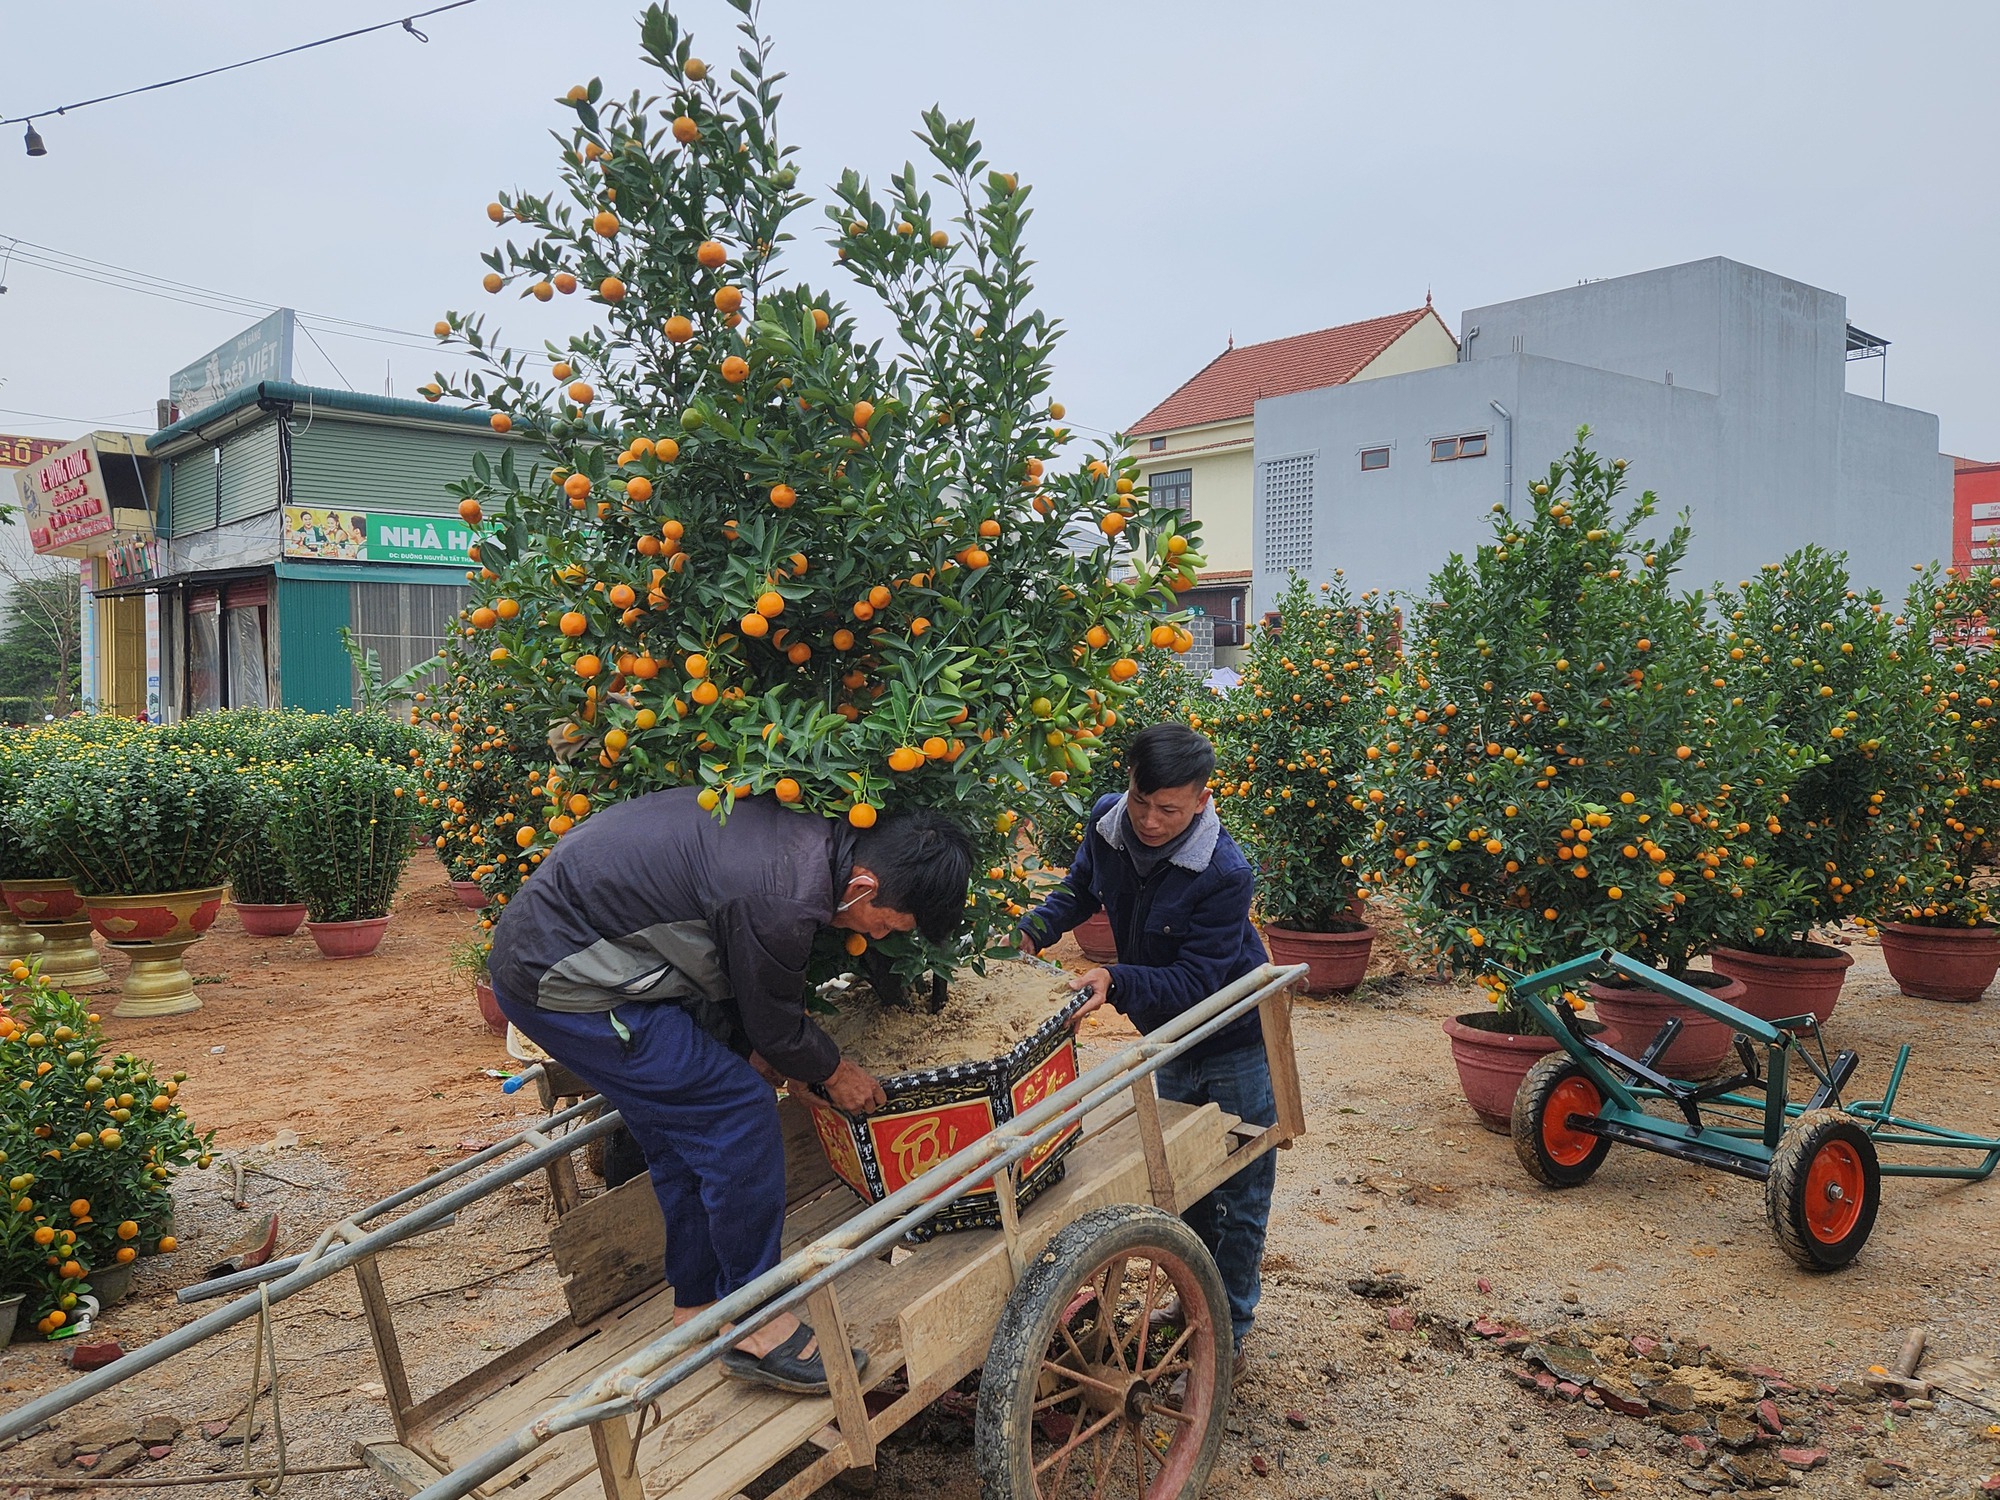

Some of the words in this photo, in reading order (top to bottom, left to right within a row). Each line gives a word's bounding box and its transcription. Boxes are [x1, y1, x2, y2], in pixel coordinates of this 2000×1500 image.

[224, 355, 246, 390] BẾP
[247, 341, 278, 378] VIỆT
[66, 449, 88, 479] LONG
[380, 523, 442, 549] NHÀ
